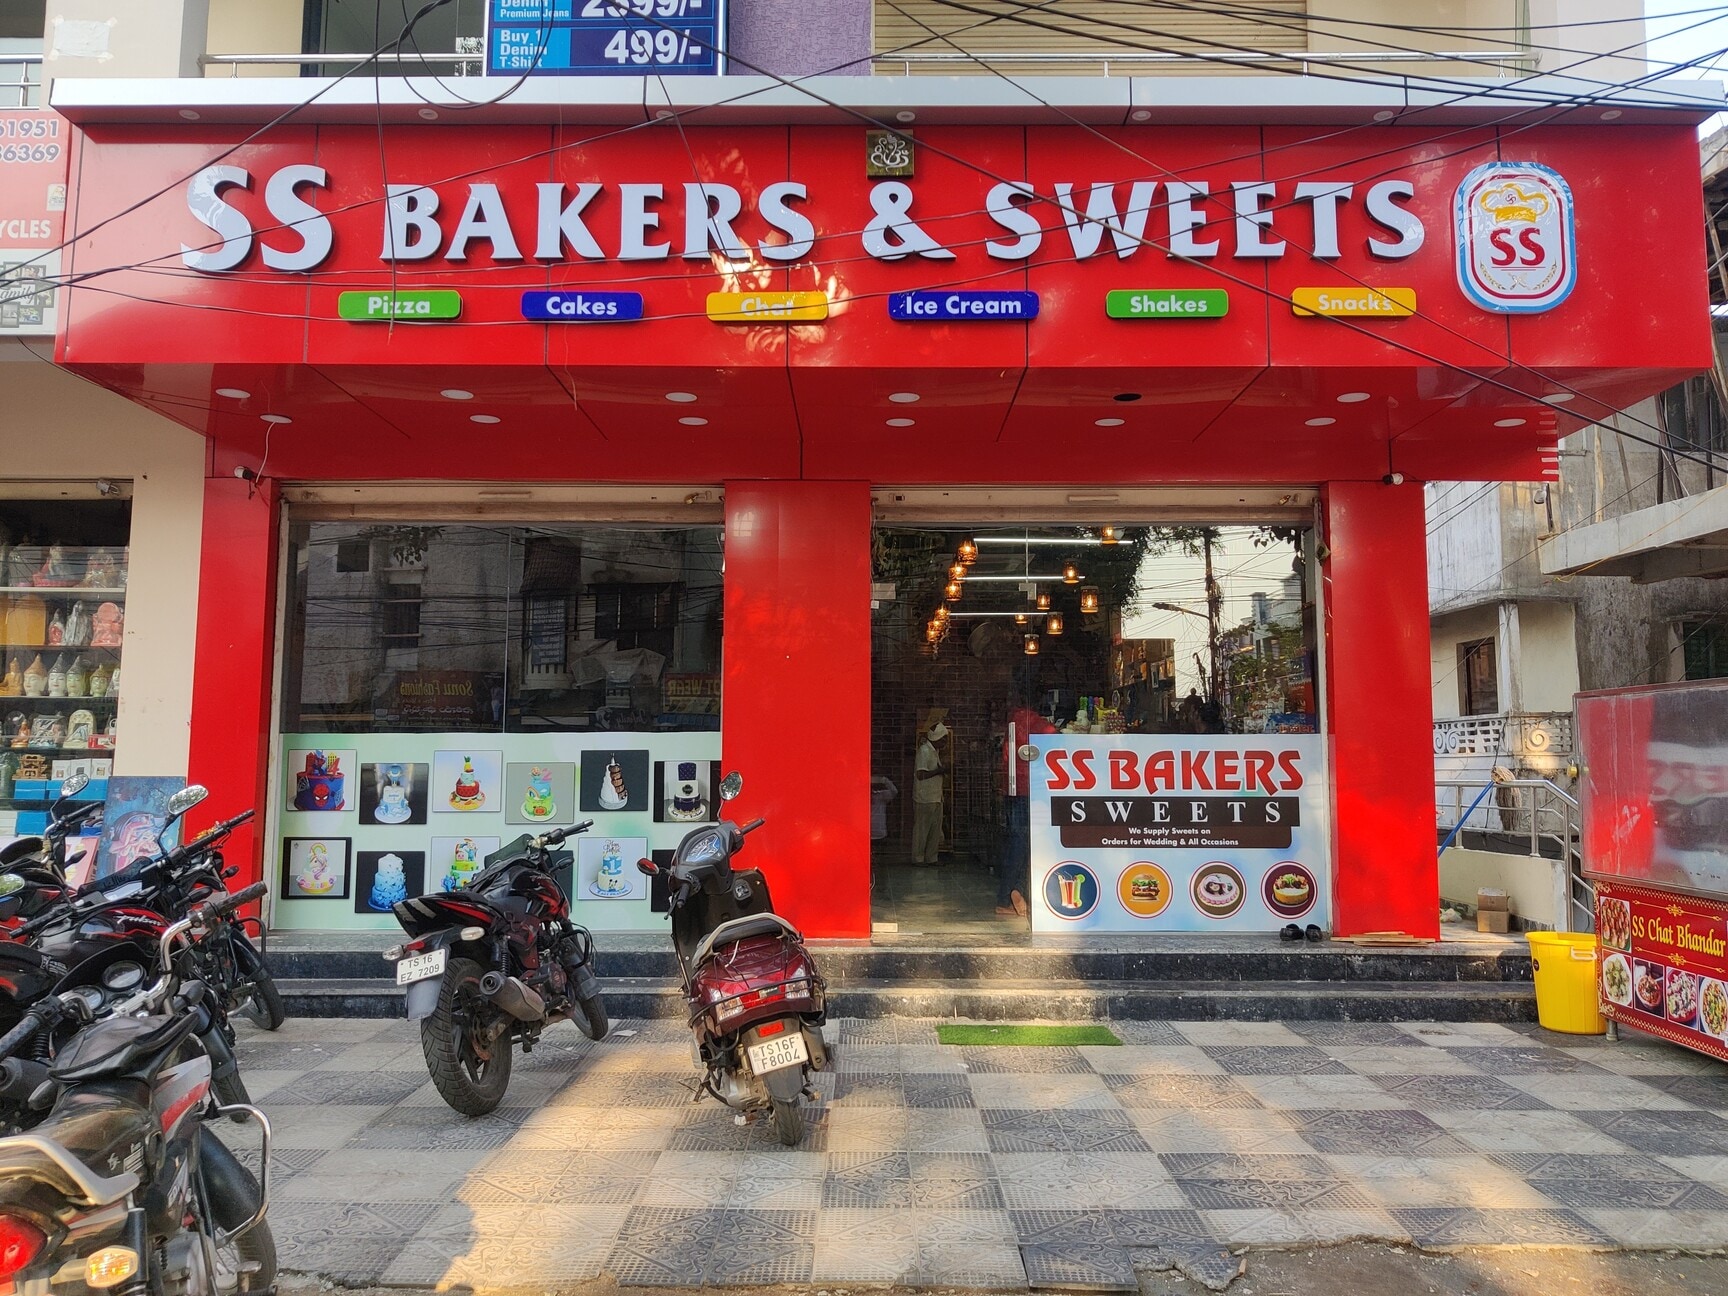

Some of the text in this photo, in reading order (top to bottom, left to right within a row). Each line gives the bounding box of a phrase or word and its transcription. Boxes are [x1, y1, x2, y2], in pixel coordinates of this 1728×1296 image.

[500, 9, 570, 18] Premium Jeans
[501, 29, 530, 44] Buy
[500, 43, 548, 56] Denim
[604, 29, 702, 64] 499/-
[499, 57, 543, 68] T-Shit
[0, 144, 60, 162] 6369
[180, 164, 1426, 272] SS BAKERS & SWEETS
[1490, 227, 1547, 267] SS
[367, 296, 431, 315] Pizza
[545, 295, 618, 315] Cakes
[740, 297, 796, 317] Chat
[905, 296, 1022, 315] Ice Cream
[1129, 295, 1208, 314] Shakes
[1317, 293, 1393, 312] Snacks
[1045, 749, 1305, 796] SS BAKERS
[1071, 800, 1282, 824] SWEETS
[1128, 827, 1142, 835] We
[1143, 827, 1170, 836] Supply
[1171, 827, 1199, 835] Sweets
[1101, 838, 1239, 847] Orders for Wedding & All Occasions
[1631, 914, 1726, 958] SS Chat Bhandar
[407, 954, 433, 969] TS 16
[400, 963, 440, 983] EZ 7209
[761, 1048, 801, 1070] F8004
